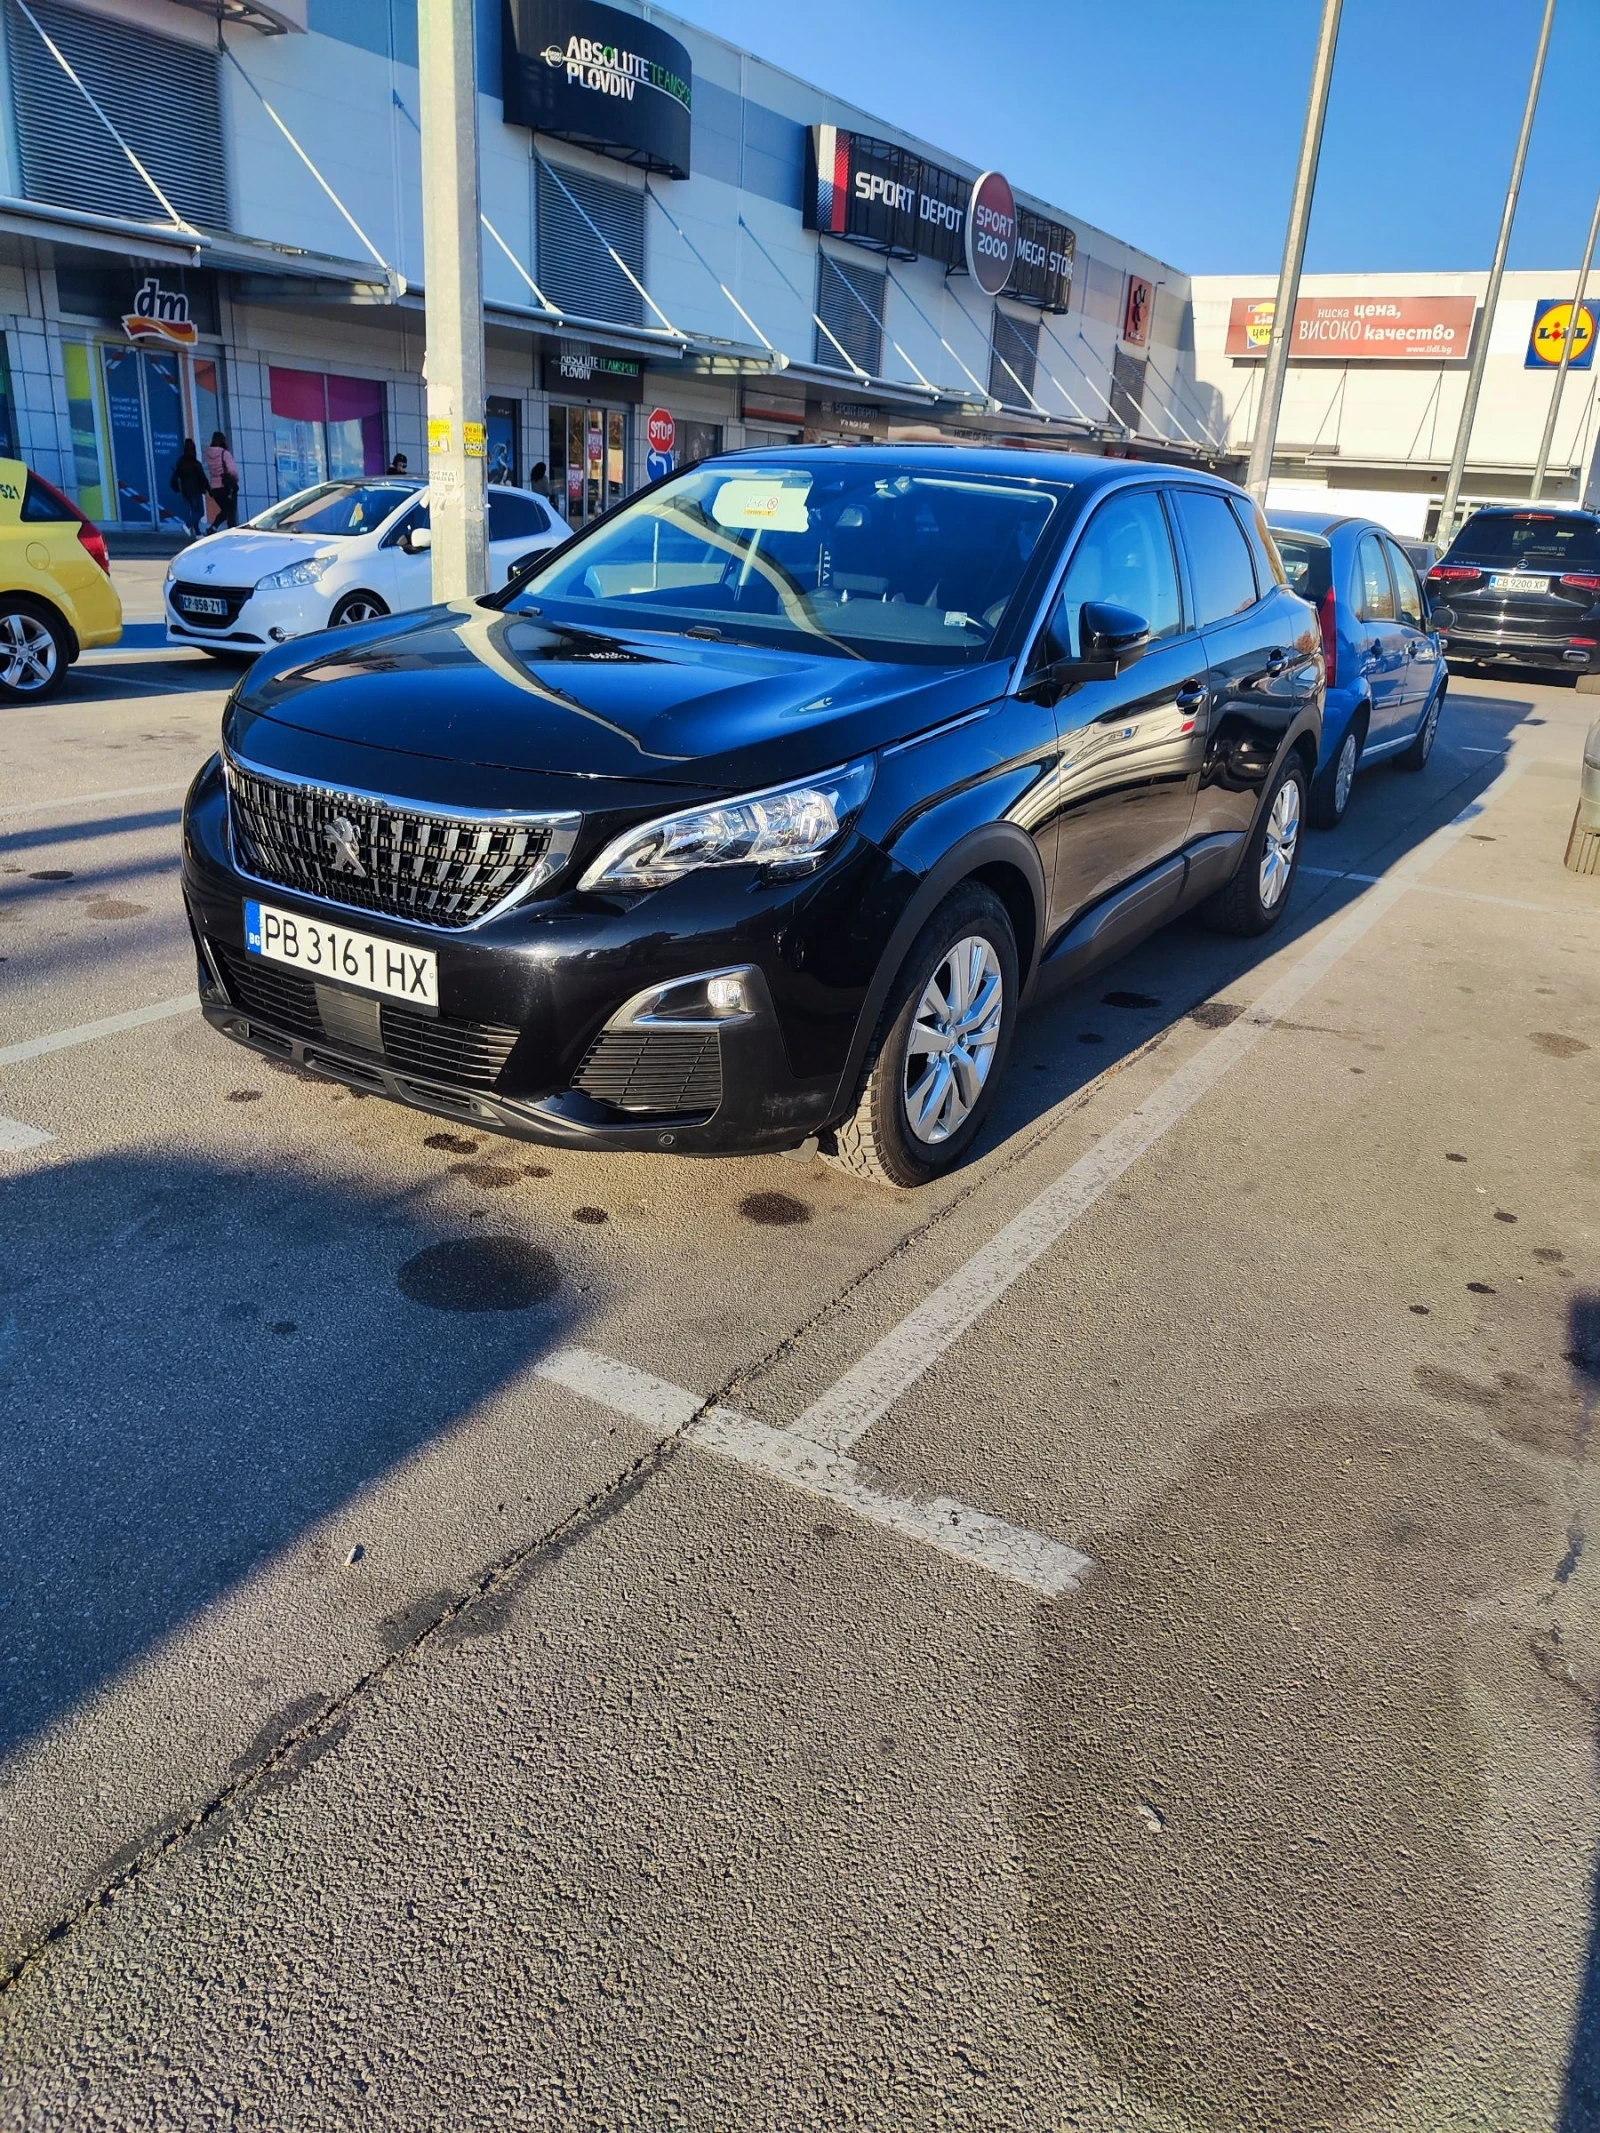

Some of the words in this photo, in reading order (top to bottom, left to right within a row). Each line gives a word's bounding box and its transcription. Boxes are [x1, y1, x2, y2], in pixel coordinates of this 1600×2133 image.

[567, 36, 649, 81] ABSOLUTE
[650, 62, 691, 105] TEAMSPO
[566, 62, 635, 101] PLOVDIV
[855, 171, 915, 214] SPORT
[919, 194, 963, 233] DEPOT
[976, 205, 1014, 238] SPORT
[977, 232, 1008, 261] 2000
[1017, 237, 1046, 268] MEGA
[135, 278, 188, 322] dm
[1317, 308, 1349, 318] ниска
[1353, 304, 1401, 319] цена,
[1252, 328, 1272, 340] цен
[1299, 320, 1362, 341] ВИСОКО
[1364, 324, 1455, 341] качество
[1406, 345, 1452, 354] www.lidl.bg
[560, 355, 599, 369] ABSOLUTE
[560, 365, 592, 381] PLOVDIV
[650, 421, 672, 440] STOP
[1496, 576, 1508, 587] CB
[1511, 577, 1531, 588] 9200
[1534, 579, 1547, 590] XP
[306, 784, 380, 807] PEUGEOT
[249, 932, 260, 946] BG
